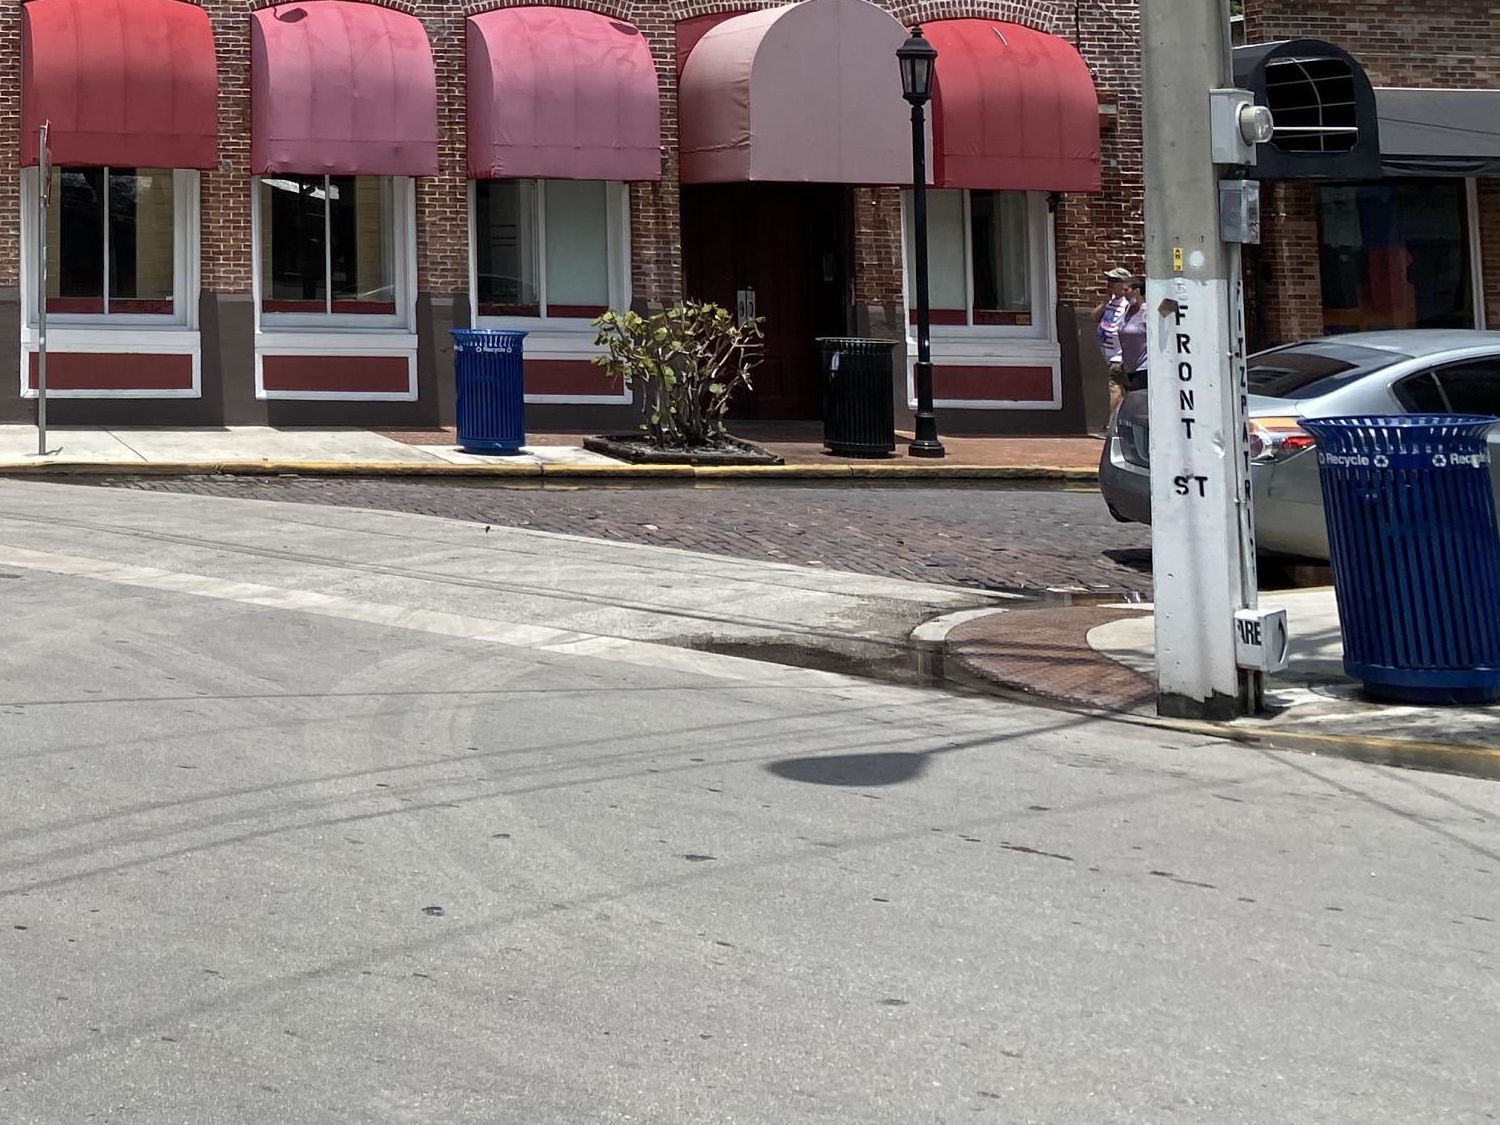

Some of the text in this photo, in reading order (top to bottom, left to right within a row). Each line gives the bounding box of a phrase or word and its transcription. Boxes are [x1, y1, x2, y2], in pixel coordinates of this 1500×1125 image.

[1175, 305, 1196, 439] FRONT
[1326, 453, 1369, 467] Recycle
[1174, 476, 1208, 498] ST
